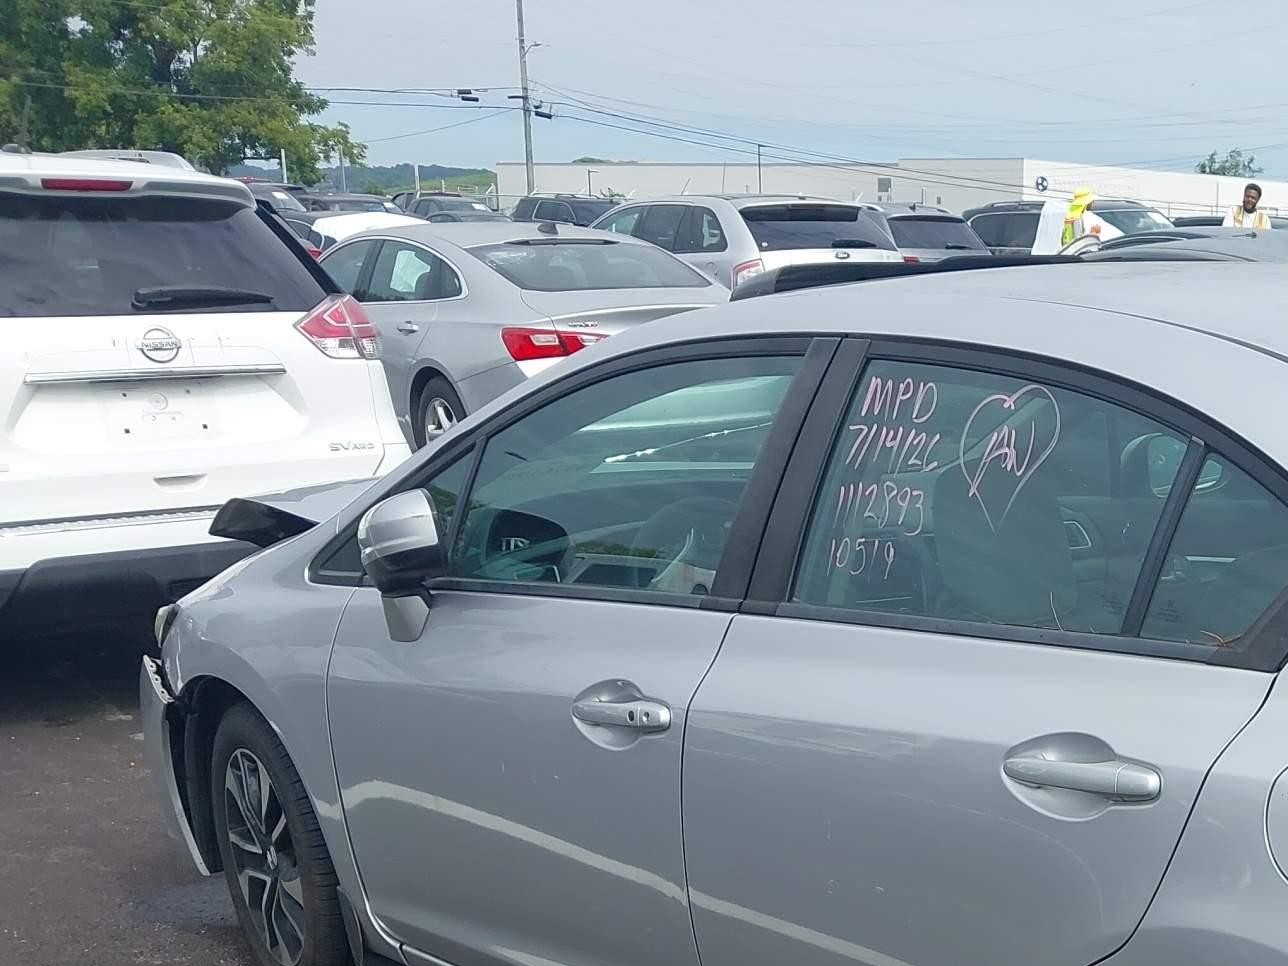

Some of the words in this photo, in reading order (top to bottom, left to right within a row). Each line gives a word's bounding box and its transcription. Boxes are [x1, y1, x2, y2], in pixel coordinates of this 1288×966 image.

[141, 339, 178, 349] NISSAN
[861, 377, 938, 424] MPD
[328, 440, 351, 452] SV
[845, 424, 940, 478] 7/14/26
[833, 481, 924, 535] 1112893
